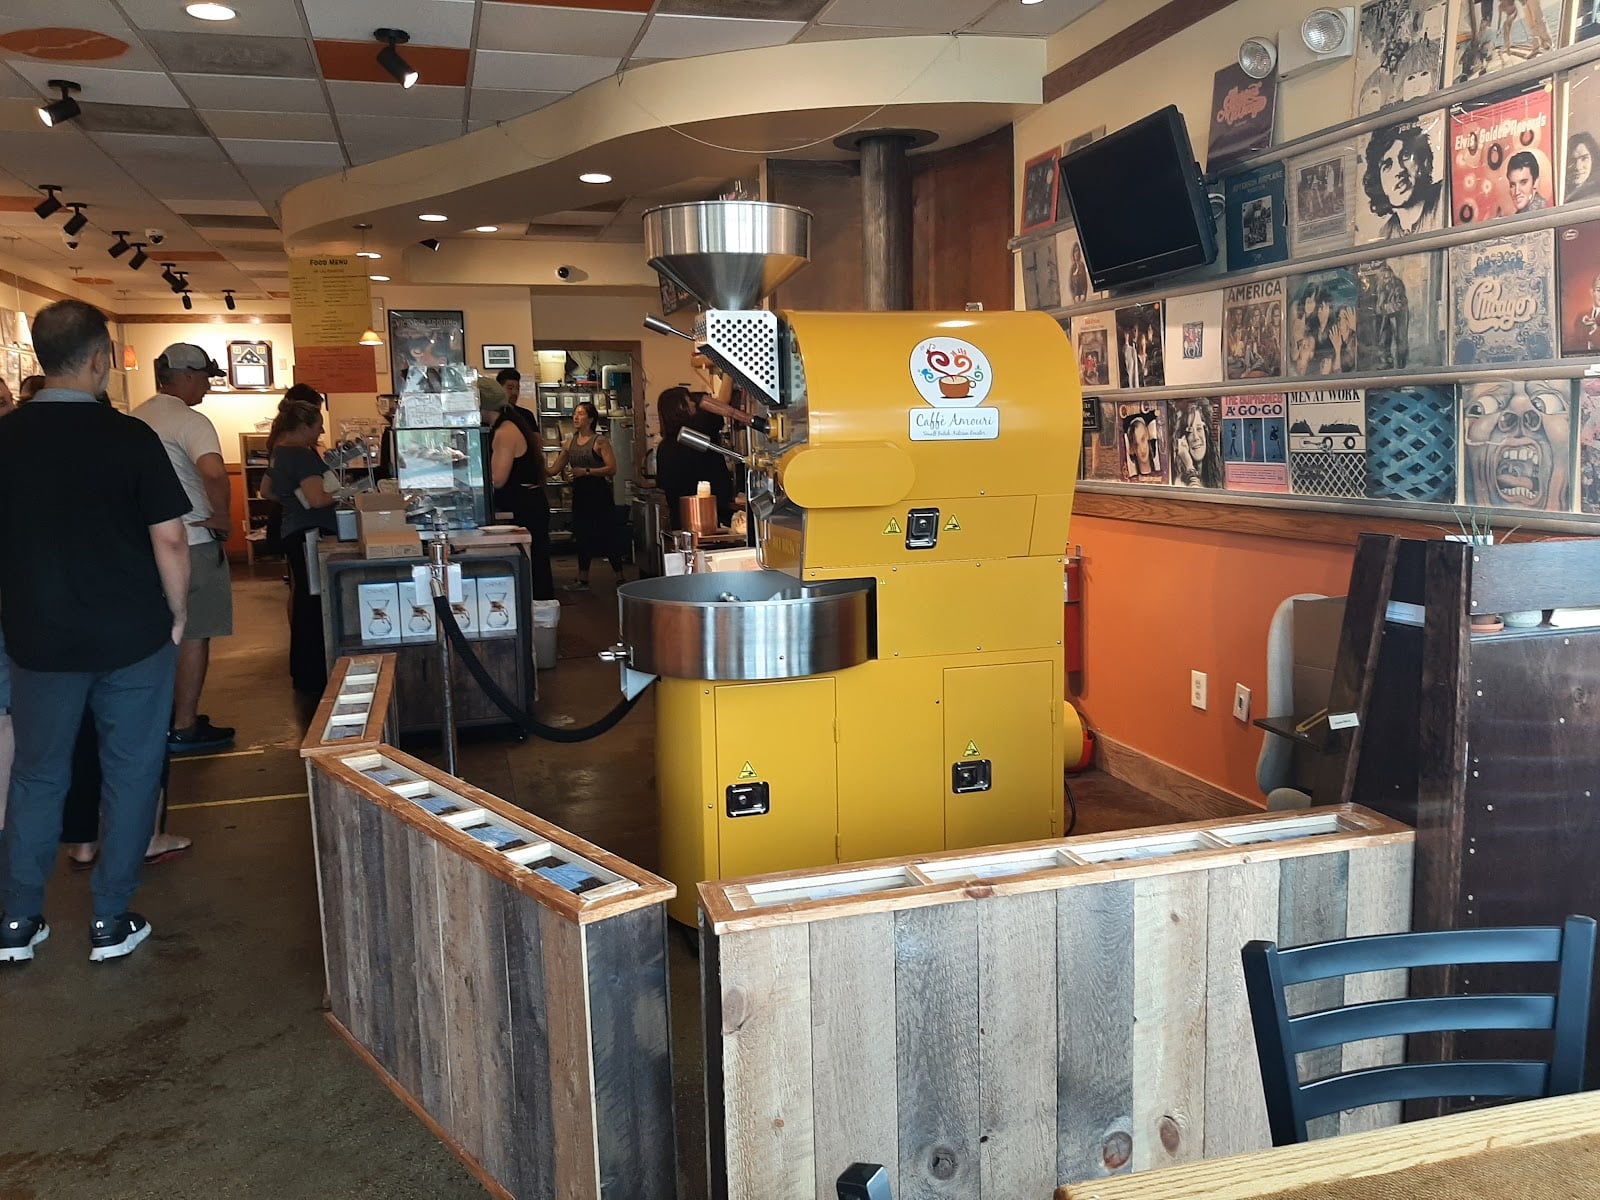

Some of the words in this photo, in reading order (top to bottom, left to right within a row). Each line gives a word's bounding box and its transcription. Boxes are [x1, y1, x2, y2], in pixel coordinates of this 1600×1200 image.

[309, 258, 328, 266] FOOD
[329, 258, 349, 266] MENU
[1227, 279, 1282, 303] AMERICA
[1463, 277, 1538, 335] Chicago
[1291, 391, 1311, 403] MEN
[1312, 390, 1324, 402] AT
[1328, 388, 1360, 401] WORK
[948, 413, 993, 427] Amouri
